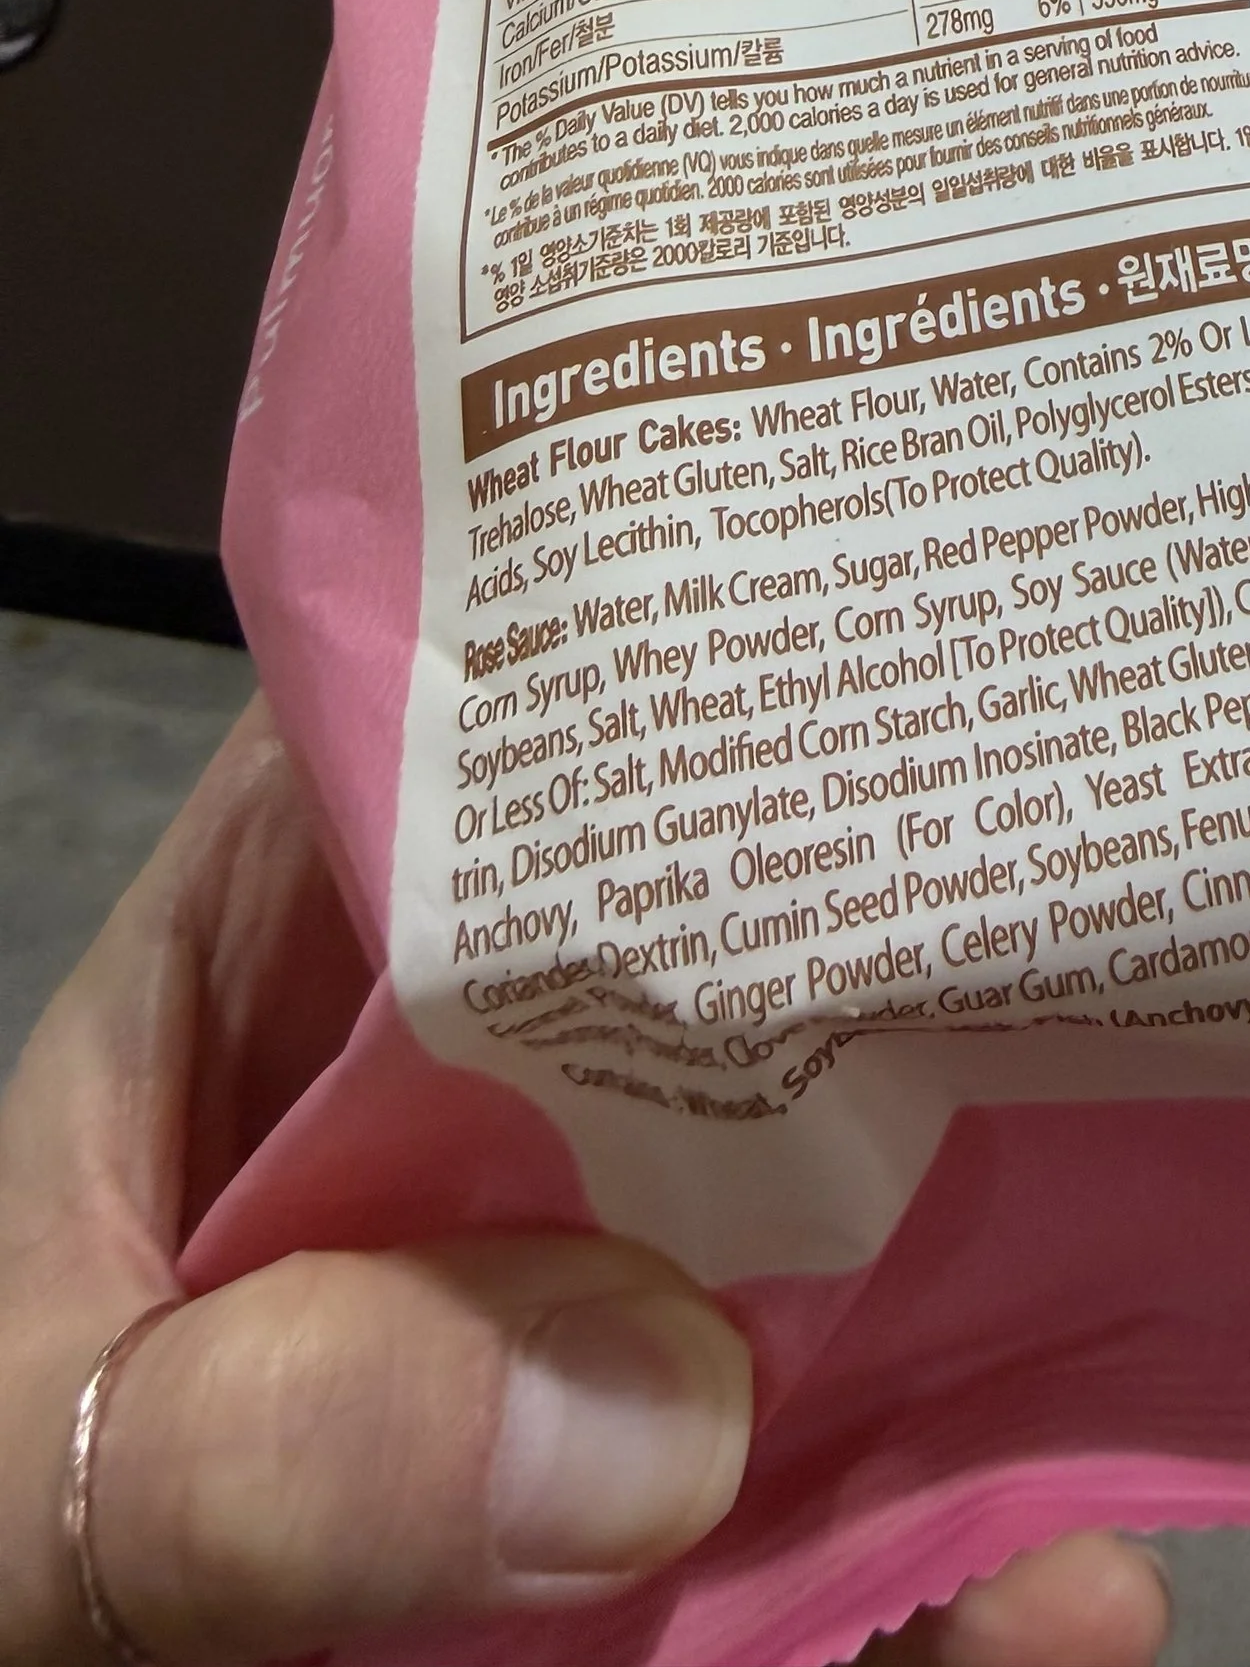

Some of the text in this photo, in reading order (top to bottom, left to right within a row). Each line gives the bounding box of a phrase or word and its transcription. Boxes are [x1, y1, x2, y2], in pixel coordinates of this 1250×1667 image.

[498, 13, 616, 90] Iron/Fer/철분
[926, 8, 996, 39] 278mg
[495, 37, 784, 130] Potassium/Potassium/칼륨
[496, 331, 765, 428] Ingredients
[809, 277, 1085, 364] Ingrédients
[467, 451, 540, 513] Wheat
[550, 432, 628, 477] Flour
[638, 415, 741, 454] Cakes:
[750, 397, 843, 438] Wheat
[851, 386, 926, 422] Flour,
[930, 370, 1016, 407] Water,
[1023, 343, 1142, 389] Contains
[1148, 327, 1193, 364] 2%
[1199, 321, 1232, 353] Or
[938, 984, 1012, 1013] Guar
[1019, 967, 1104, 1002] Gum,
